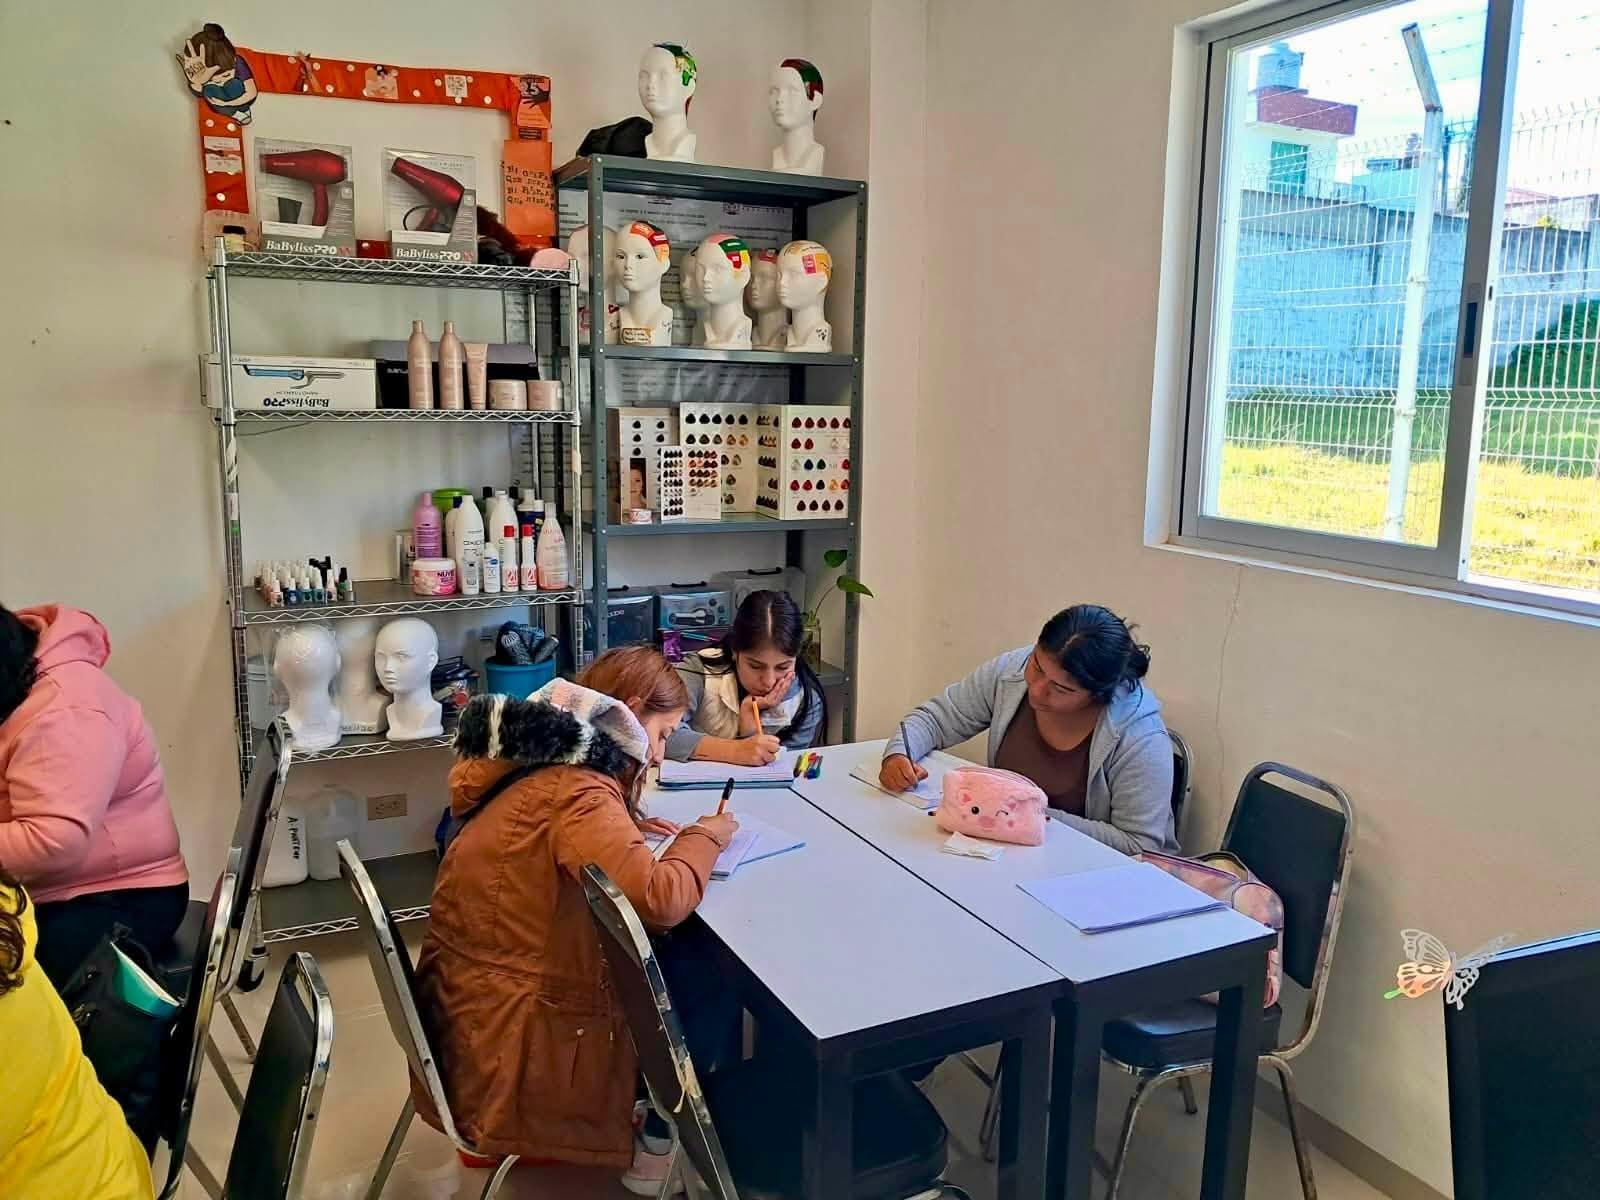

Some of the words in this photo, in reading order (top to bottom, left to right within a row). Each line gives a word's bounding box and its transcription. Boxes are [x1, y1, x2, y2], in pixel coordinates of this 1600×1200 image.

[266, 240, 337, 255] BaBylissPRO
[396, 248, 461, 261] BaBylissPRO
[263, 396, 330, 408] BaBylissPRO
